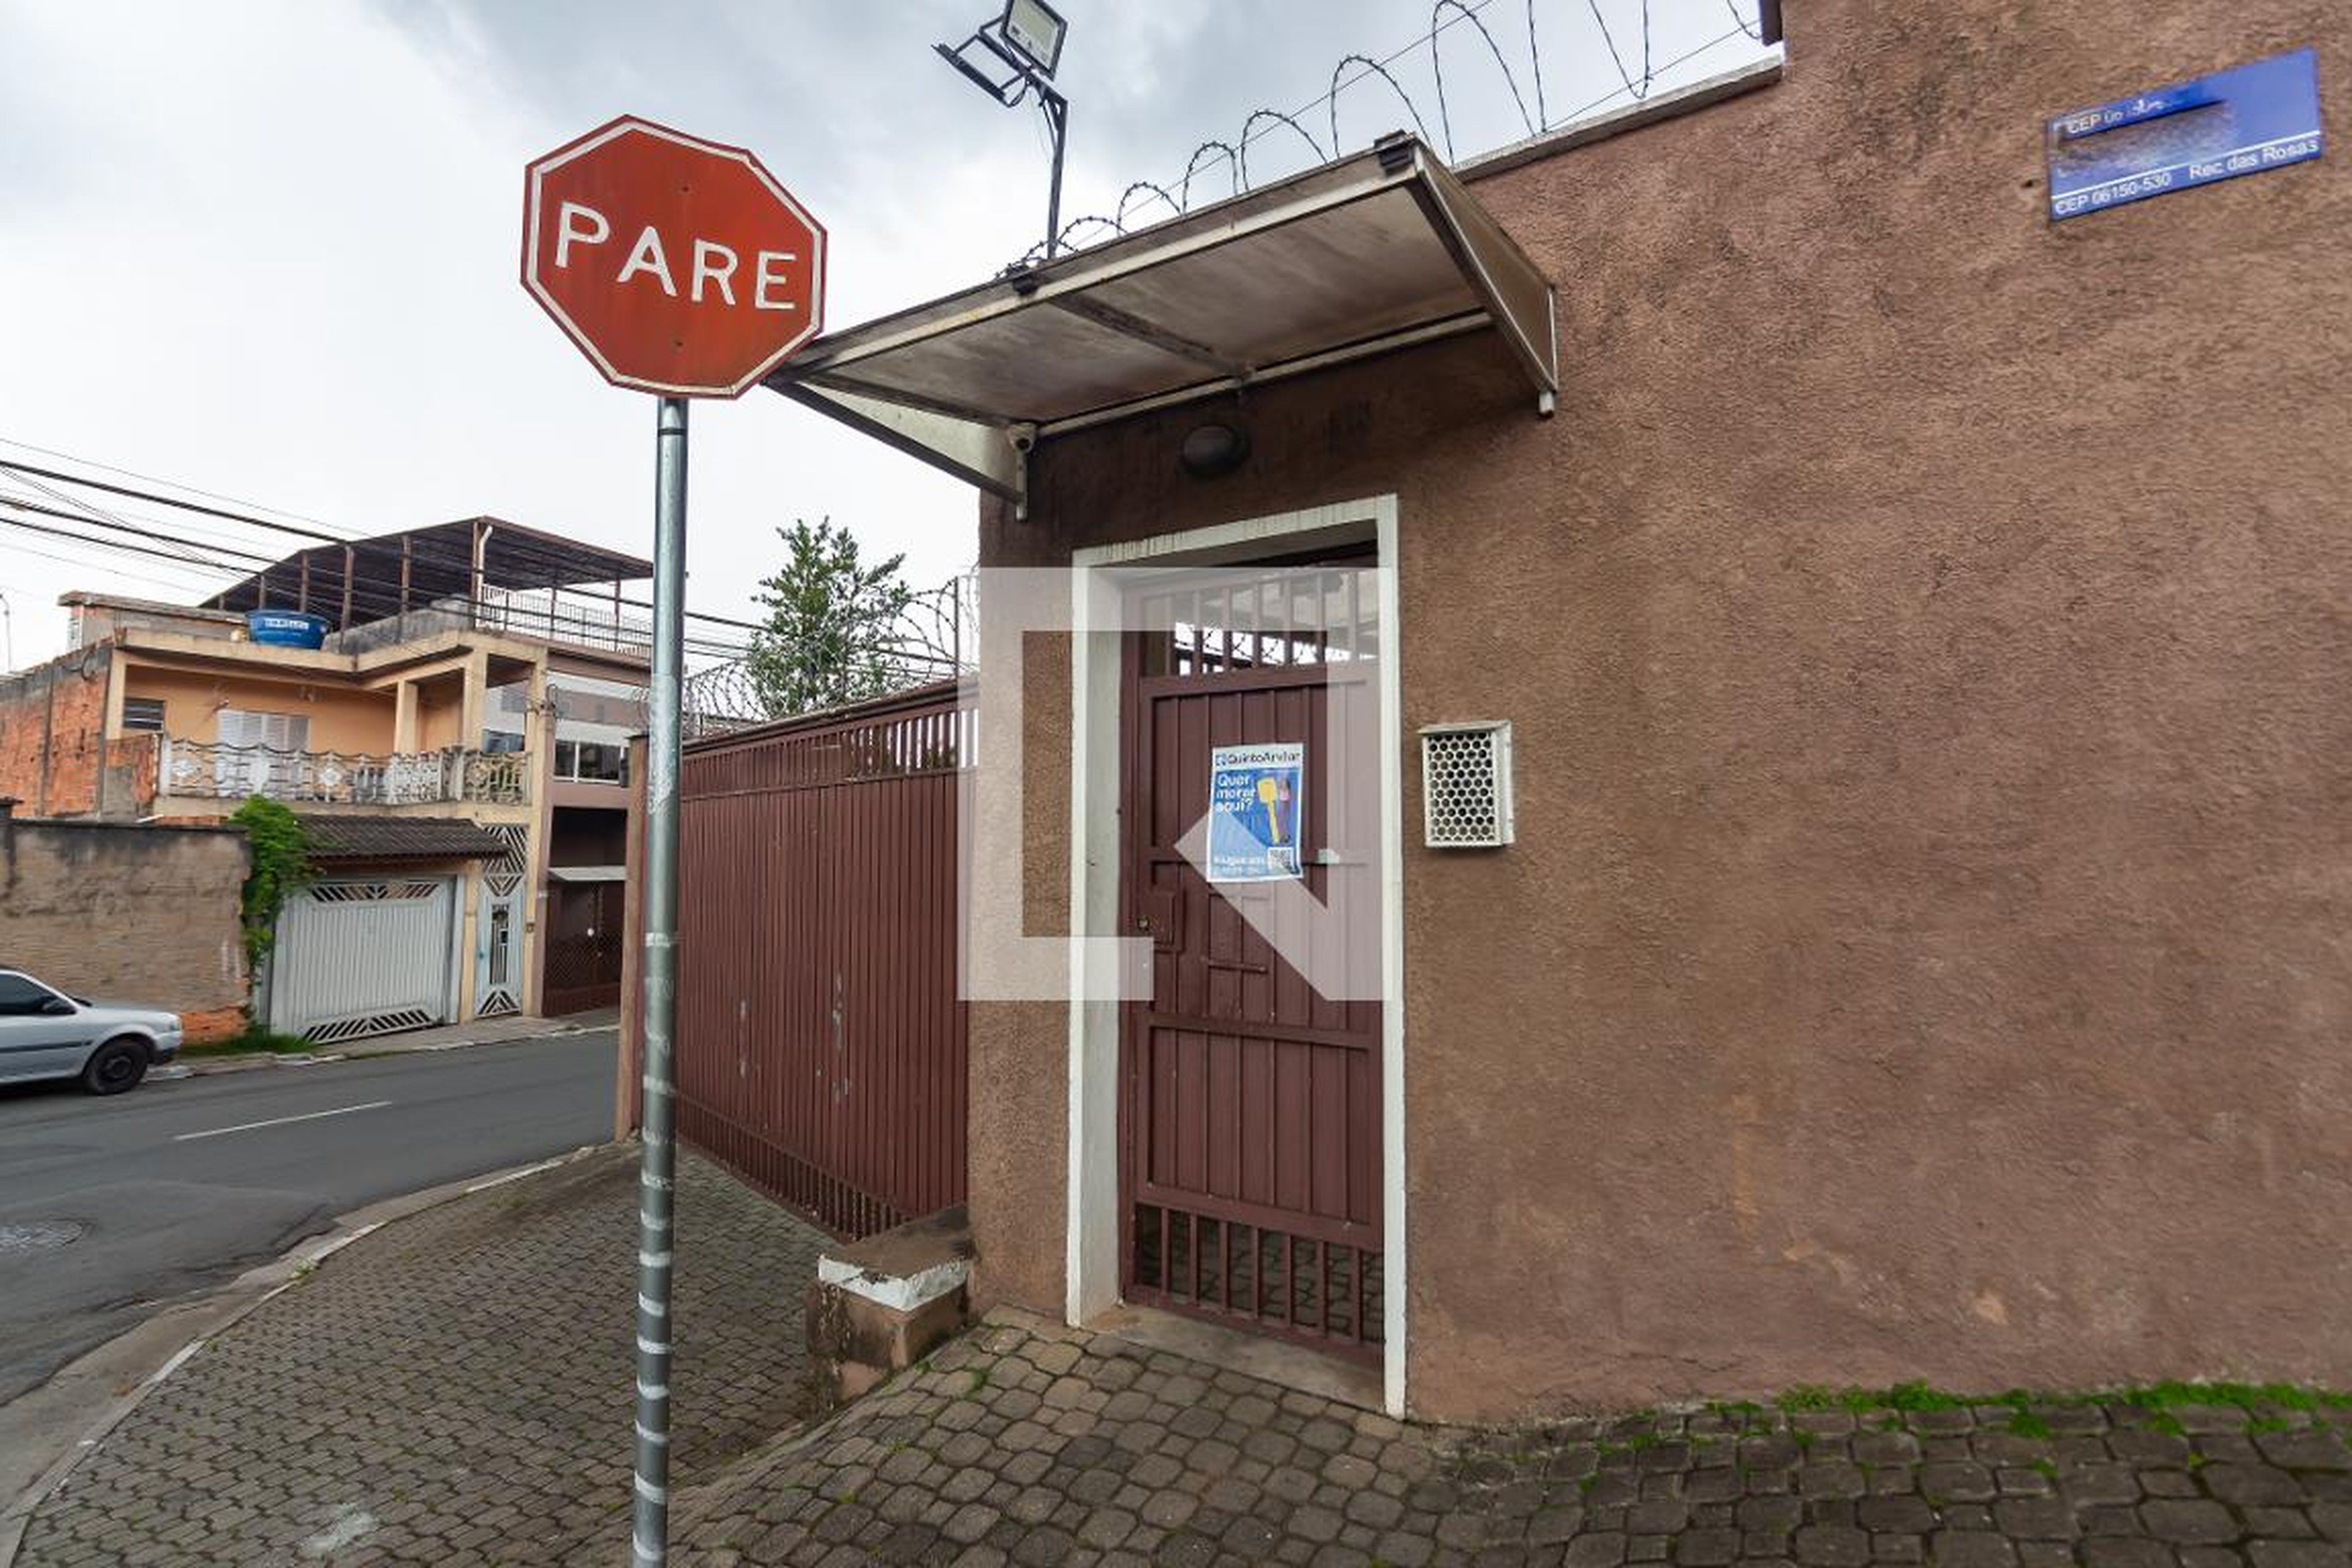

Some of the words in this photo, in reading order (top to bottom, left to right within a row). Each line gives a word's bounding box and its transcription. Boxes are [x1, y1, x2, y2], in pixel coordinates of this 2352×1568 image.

[2055, 194, 2089, 214] CEP
[2092, 172, 2173, 205] 06150-530
[2189, 162, 2223, 180] Rec
[2226, 153, 2258, 171] das
[2262, 139, 2320, 164] Rosas
[555, 201, 796, 311] PARE
[1218, 773, 1251, 787] Quer
[1214, 798, 1254, 813] aqui?
